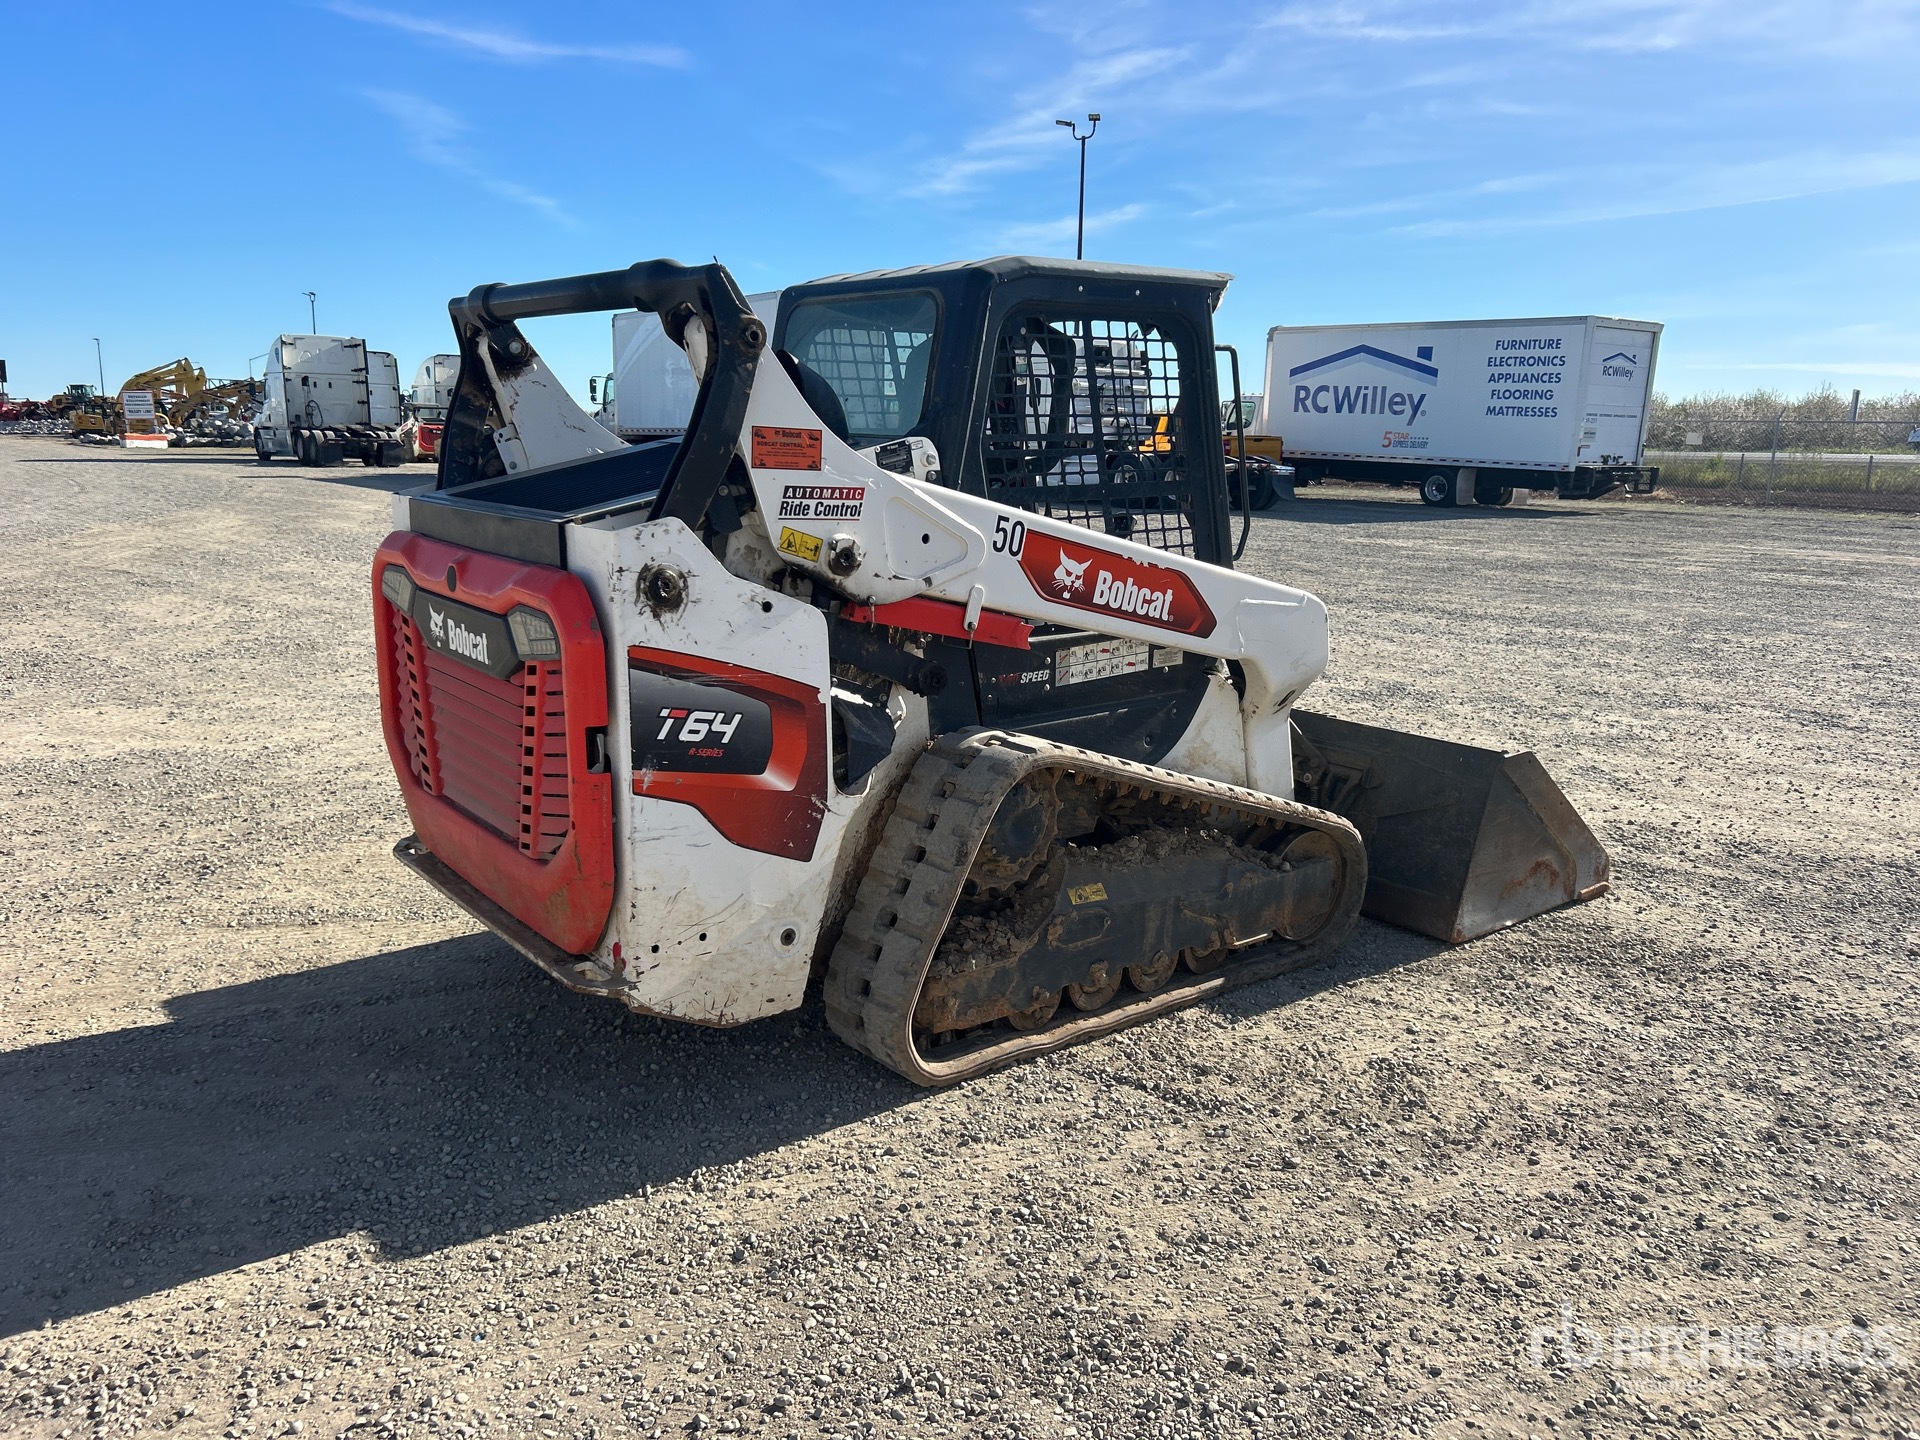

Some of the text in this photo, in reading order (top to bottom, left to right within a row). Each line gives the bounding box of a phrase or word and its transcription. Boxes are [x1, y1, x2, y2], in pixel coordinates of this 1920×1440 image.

[1495, 339, 1562, 350] FURNITURE
[1487, 356, 1566, 367] ELECTRONICS
[1487, 372, 1562, 383] APPLIANCES
[1490, 389, 1554, 400] FLOORING
[1485, 406, 1558, 417] MATTRESSES
[782, 430, 802, 438] Bobcat
[1381, 431, 1410, 448] 5 STAR
[1392, 440, 1429, 449] EXPRESS DELIVERY
[785, 487, 862, 499] AUTOMATIC
[779, 501, 863, 517] Ride Control
[992, 514, 1026, 557] 50
[1093, 569, 1173, 621] Bobcat
[447, 618, 489, 665] Bobcat
[1020, 669, 1050, 684] SPEED
[657, 708, 742, 743] T64
[688, 748, 724, 757] R-SERIES
